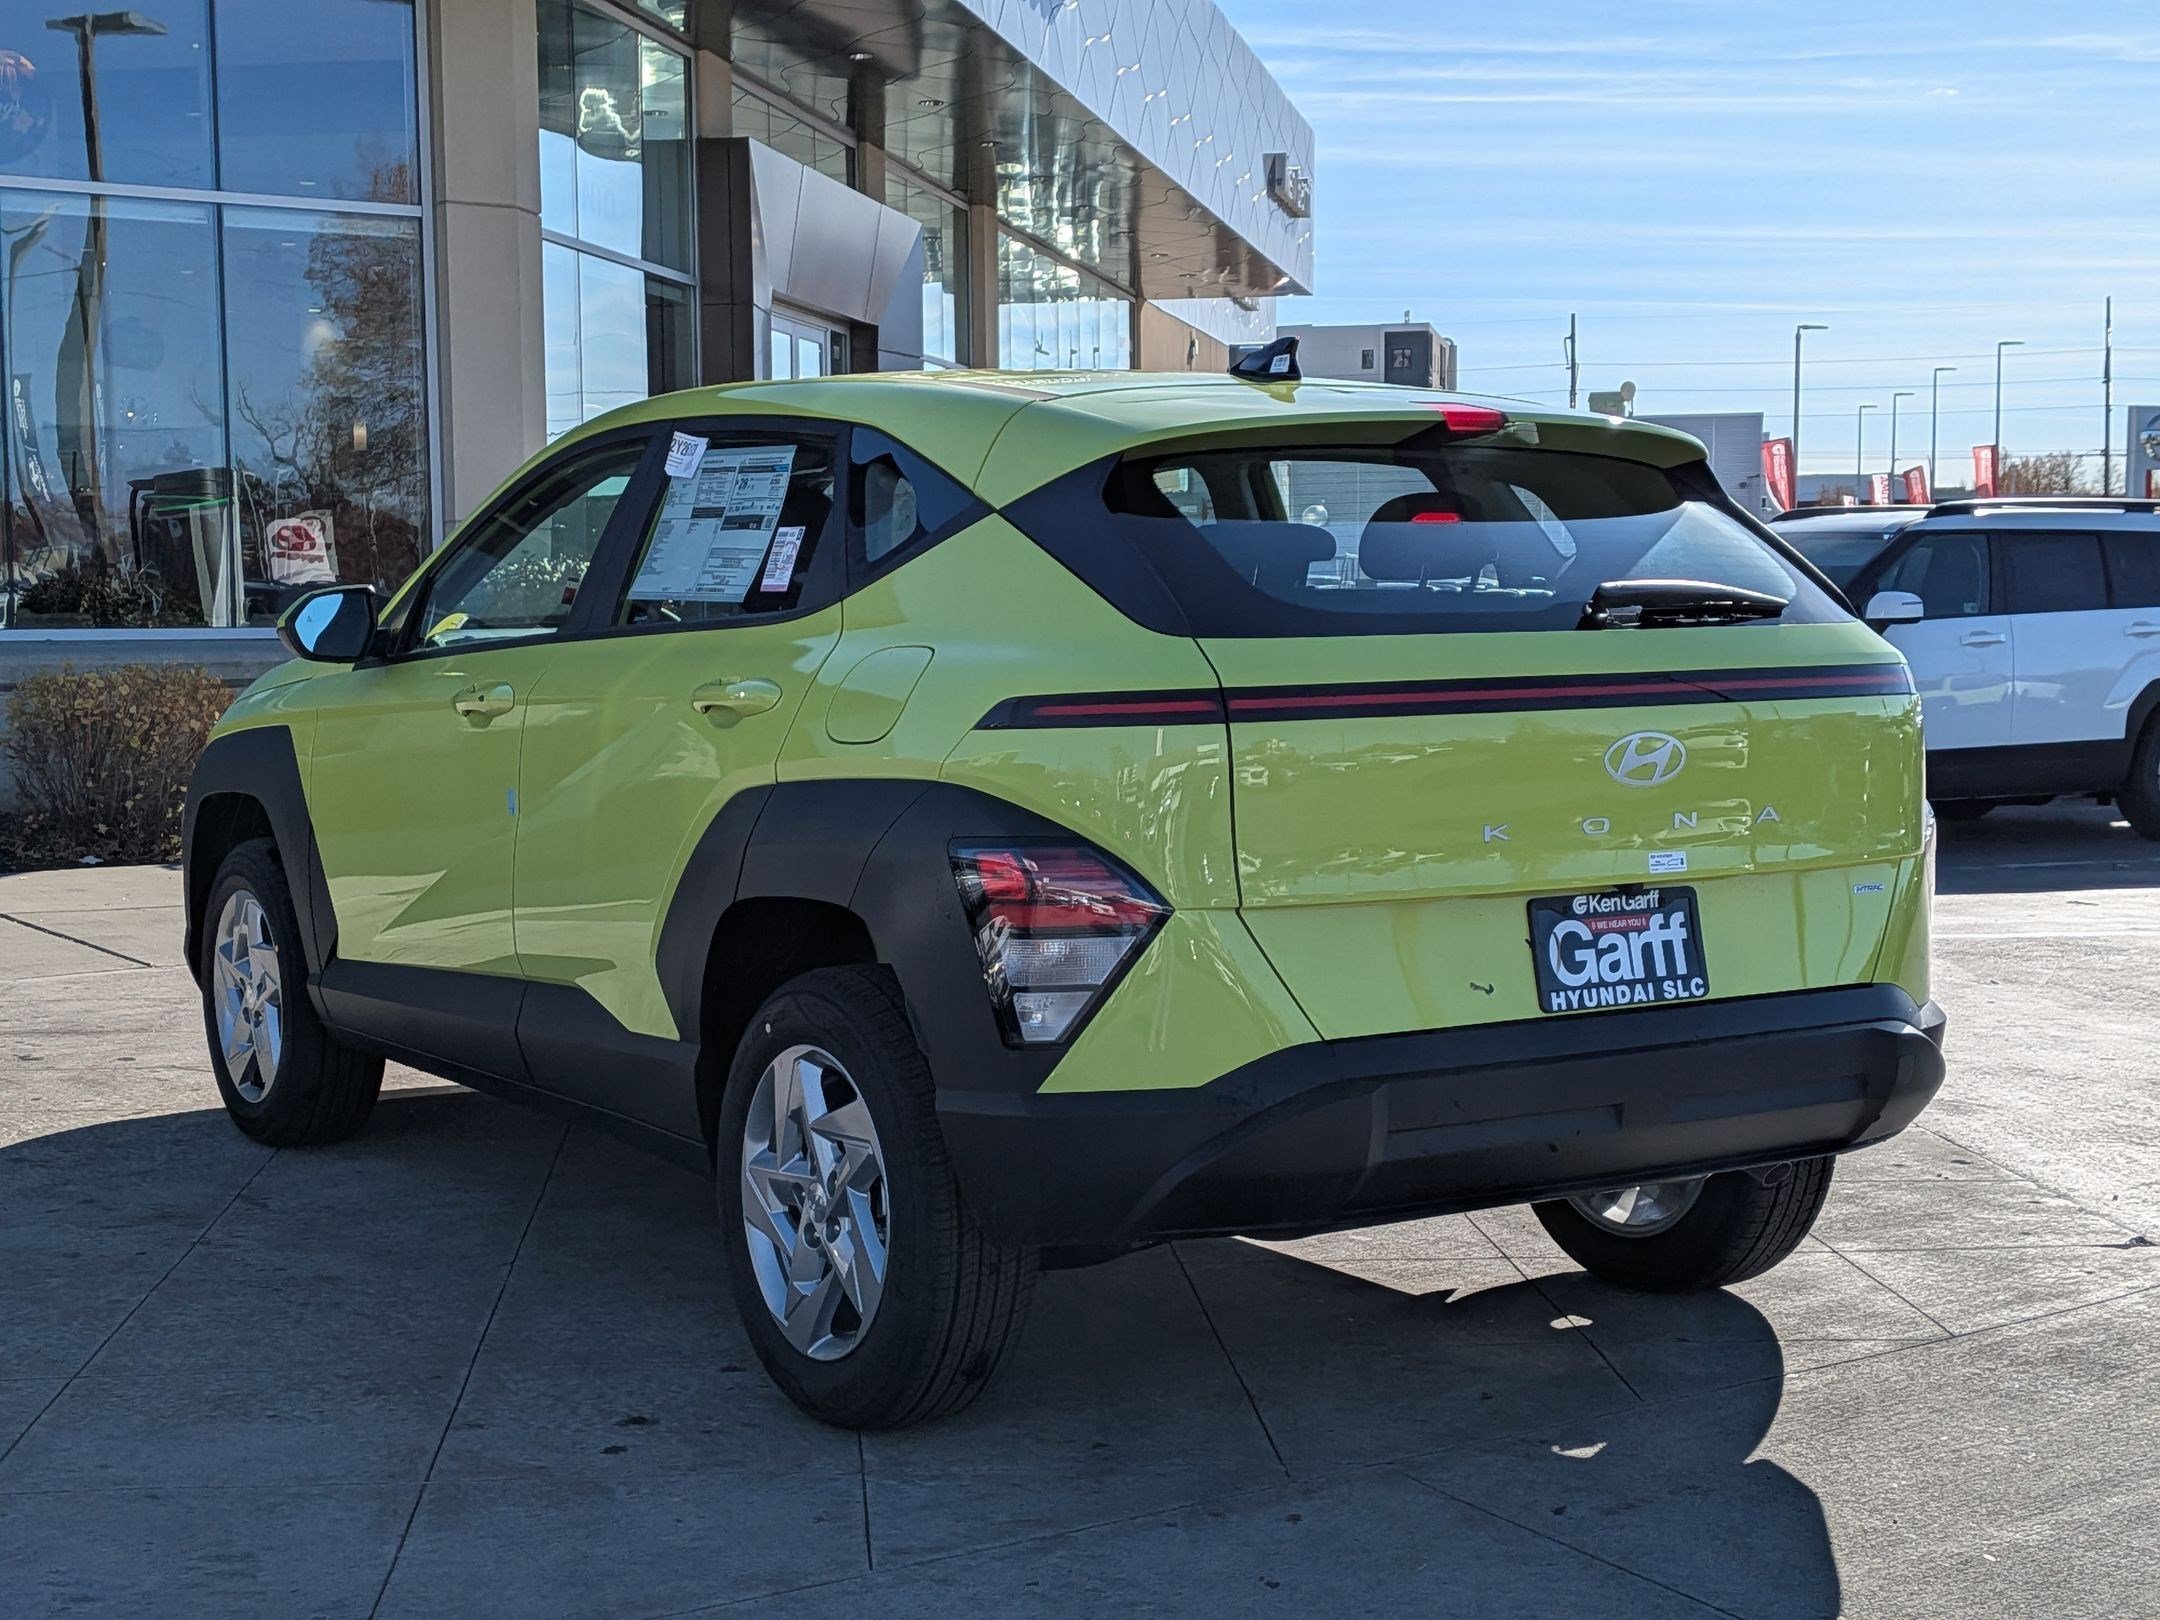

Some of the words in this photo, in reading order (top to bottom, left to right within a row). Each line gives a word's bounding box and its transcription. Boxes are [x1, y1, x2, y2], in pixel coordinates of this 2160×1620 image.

[1483, 804, 1780, 843] KONA
[1597, 921, 1608, 929] WE
[1609, 919, 1627, 929] HEAR
[1628, 918, 1641, 927] YOU
[1549, 911, 1687, 987] Garff
[1551, 982, 1655, 1011] HYUNDAI
[1663, 977, 1705, 999] SLC
